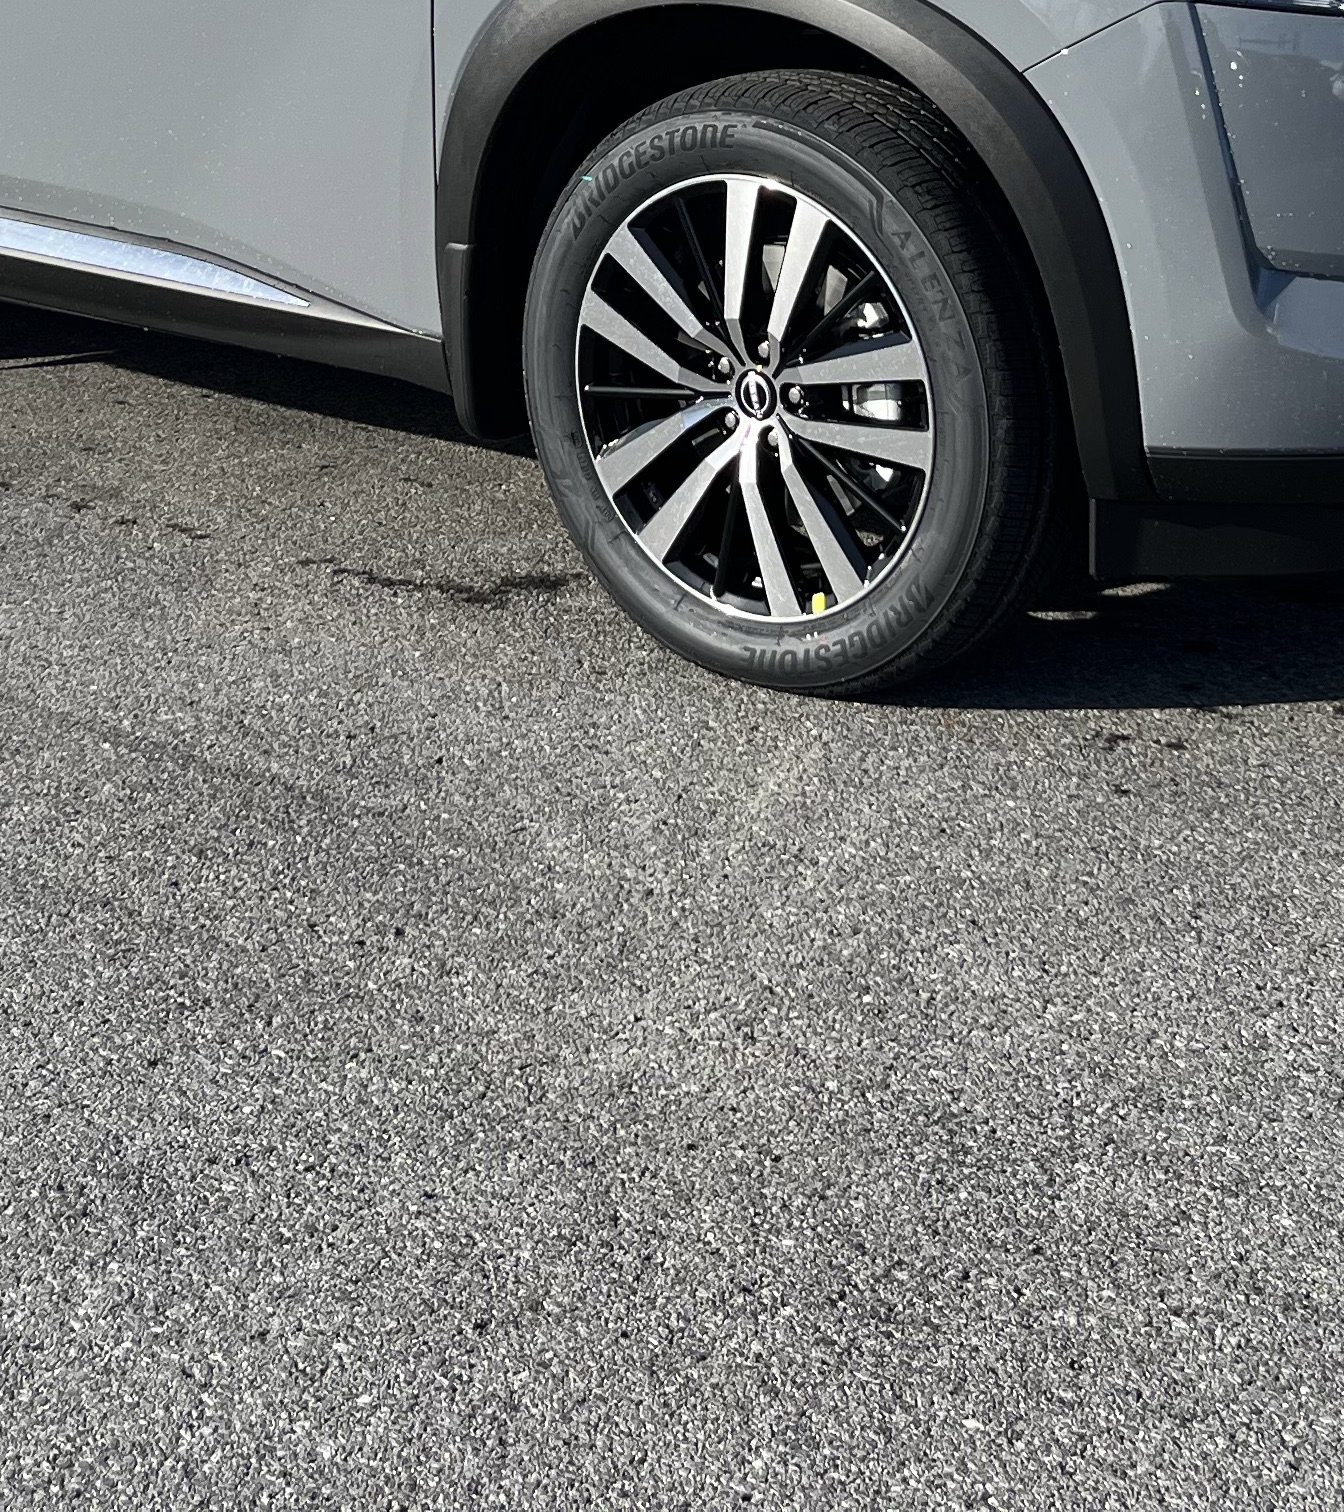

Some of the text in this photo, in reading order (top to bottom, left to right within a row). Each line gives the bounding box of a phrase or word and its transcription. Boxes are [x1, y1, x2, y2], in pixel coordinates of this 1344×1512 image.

[570, 122, 738, 240] BRIDGESTONE
[891, 230, 972, 382] ALENZA
[742, 578, 935, 675] BRIDGESTONE
